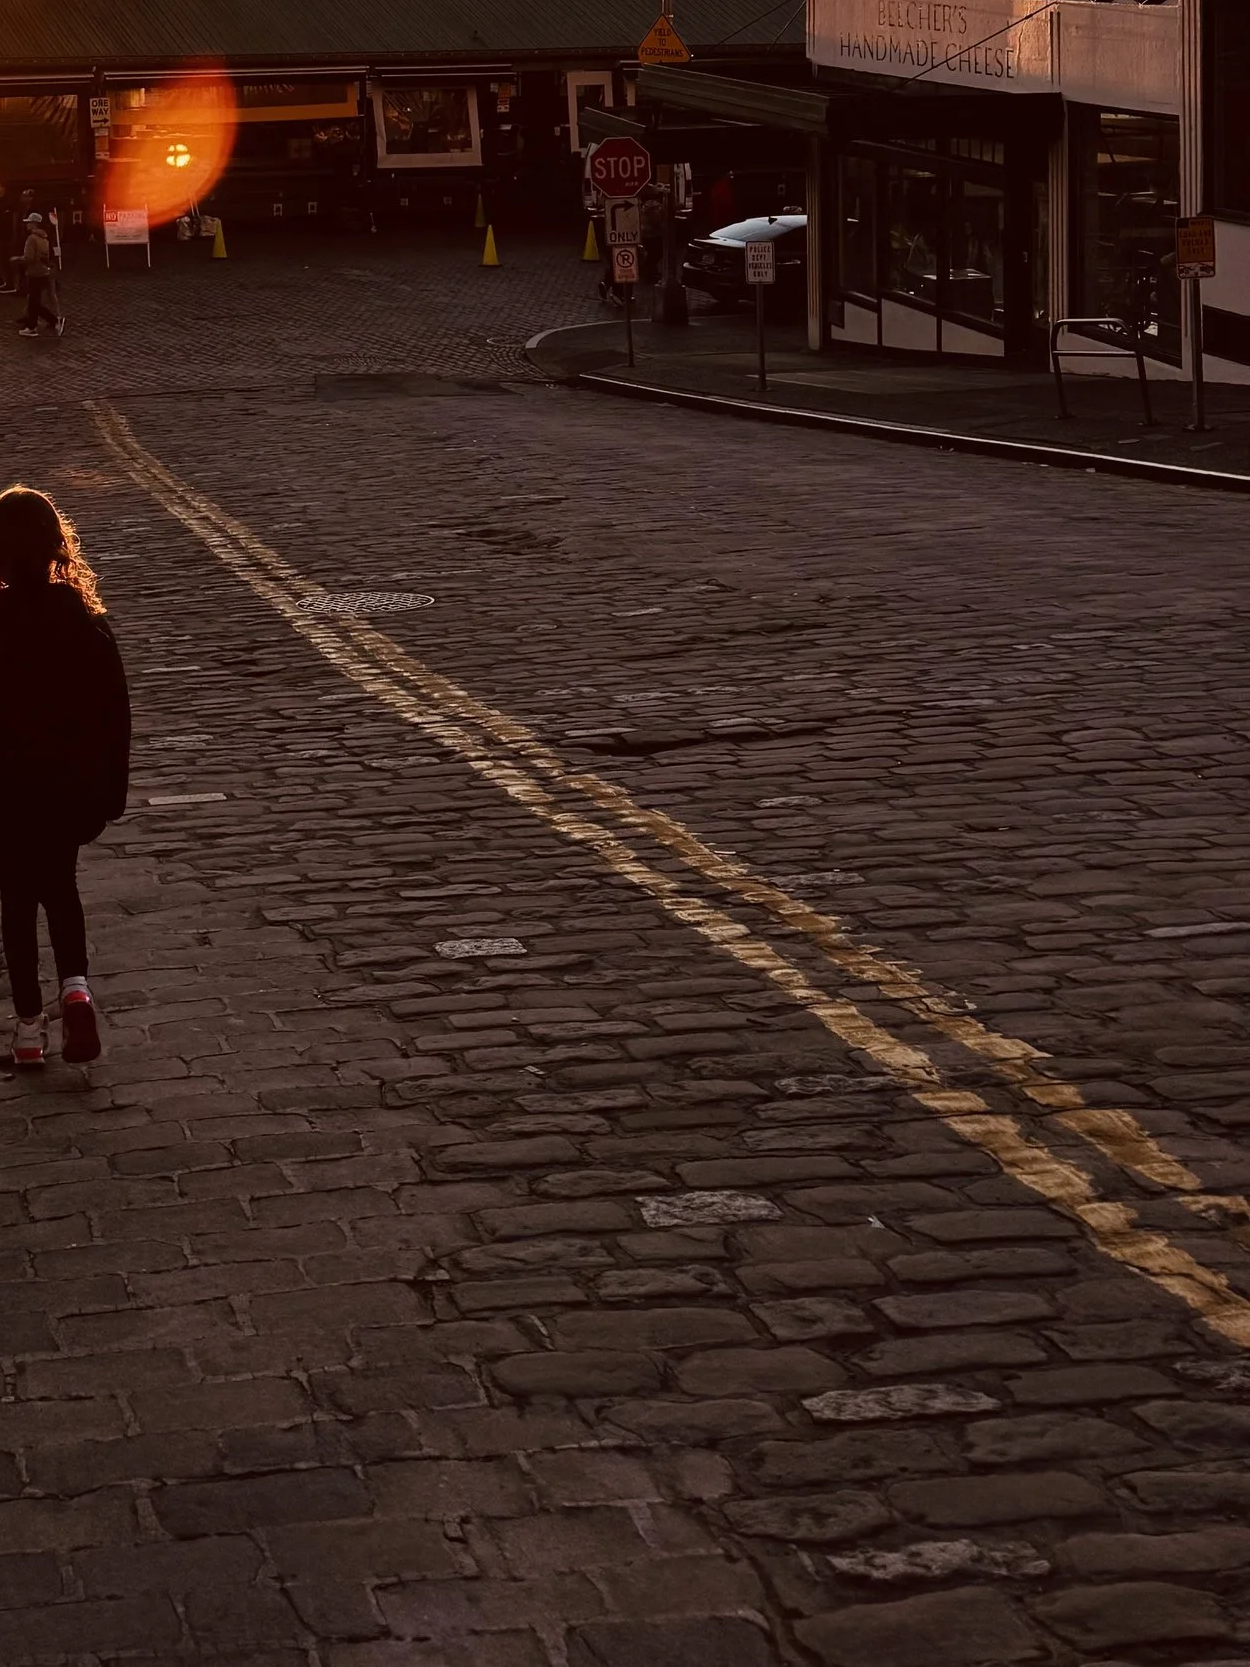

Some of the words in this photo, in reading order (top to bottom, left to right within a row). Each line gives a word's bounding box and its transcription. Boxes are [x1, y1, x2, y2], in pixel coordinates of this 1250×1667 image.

[654, 28, 672, 37] YIELD
[657, 38, 666, 46] TO
[641, 46, 683, 57] PEDESTRIANS
[839, 31, 938, 68] HANDMADE
[945, 42, 1014, 79] CHEESE
[91, 99, 108, 108] ONE
[91, 107, 109, 116] WAY
[593, 155, 646, 179] STOP
[609, 231, 639, 242] ONLY
